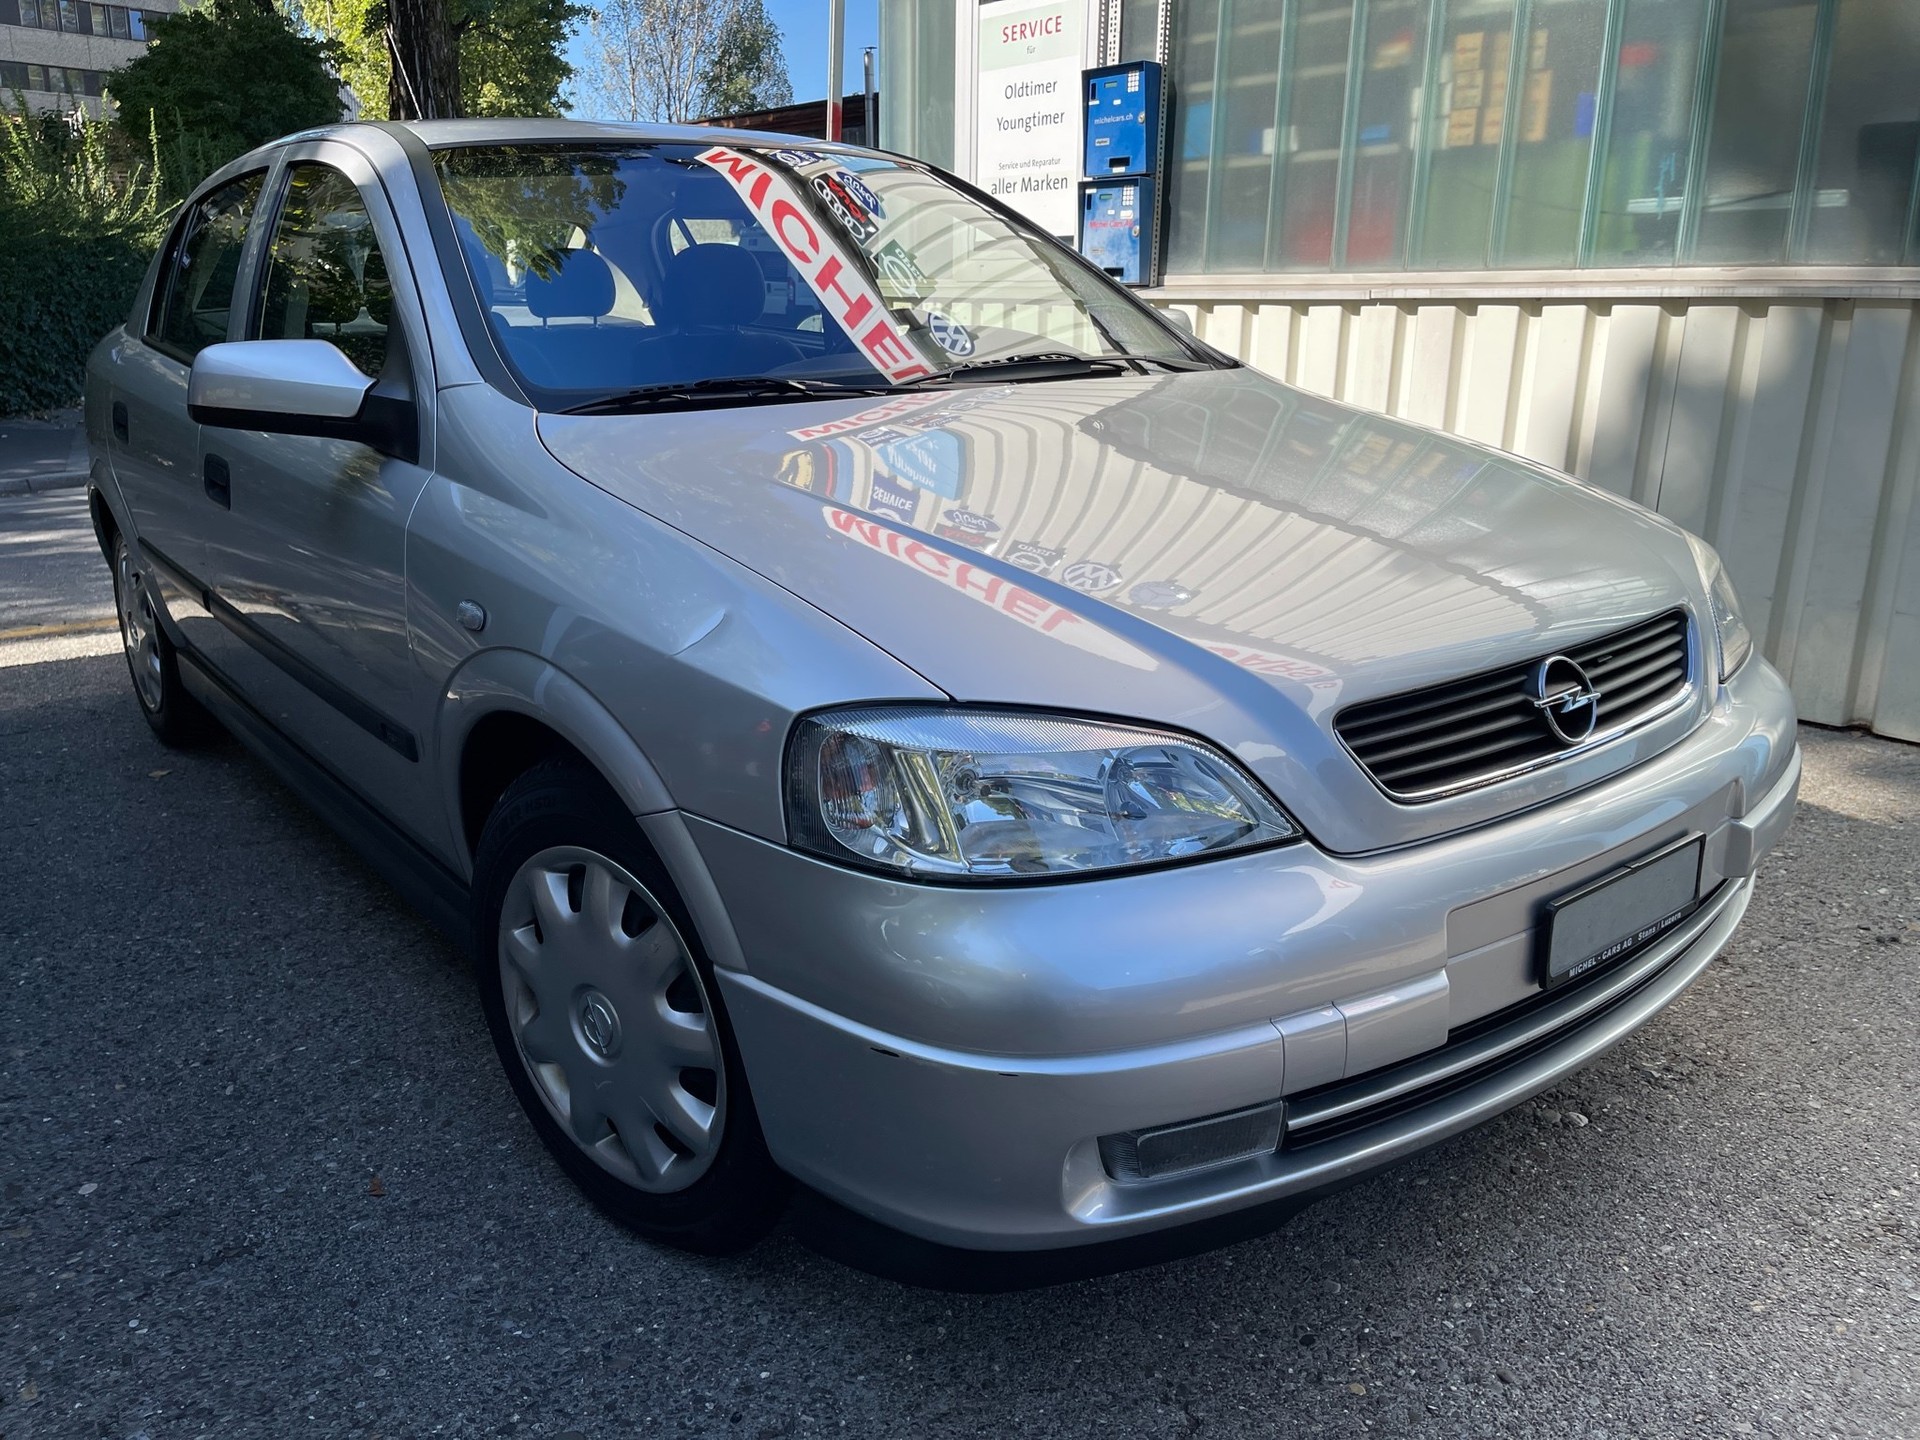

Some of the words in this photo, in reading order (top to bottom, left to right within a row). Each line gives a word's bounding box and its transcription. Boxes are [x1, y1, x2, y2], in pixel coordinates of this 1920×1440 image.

[1002, 15, 1063, 44] SERVICE
[1026, 45, 1036, 55] für
[1004, 79, 1058, 100] Oldtimer
[996, 110, 1065, 134] Youngtimer
[1094, 113, 1134, 125] michelcars.ch
[998, 160, 1019, 171] Service
[1019, 158, 1031, 169] und
[1031, 157, 1061, 170] Reparatur
[991, 178, 1018, 195] aller
[1020, 174, 1068, 194] Marken
[1568, 958, 1597, 978] MICHEL
[1602, 945, 1621, 960] CARS
[1622, 938, 1633, 950] AG
[1638, 926, 1656, 941] Stans
[1661, 912, 1682, 928] Luzern
